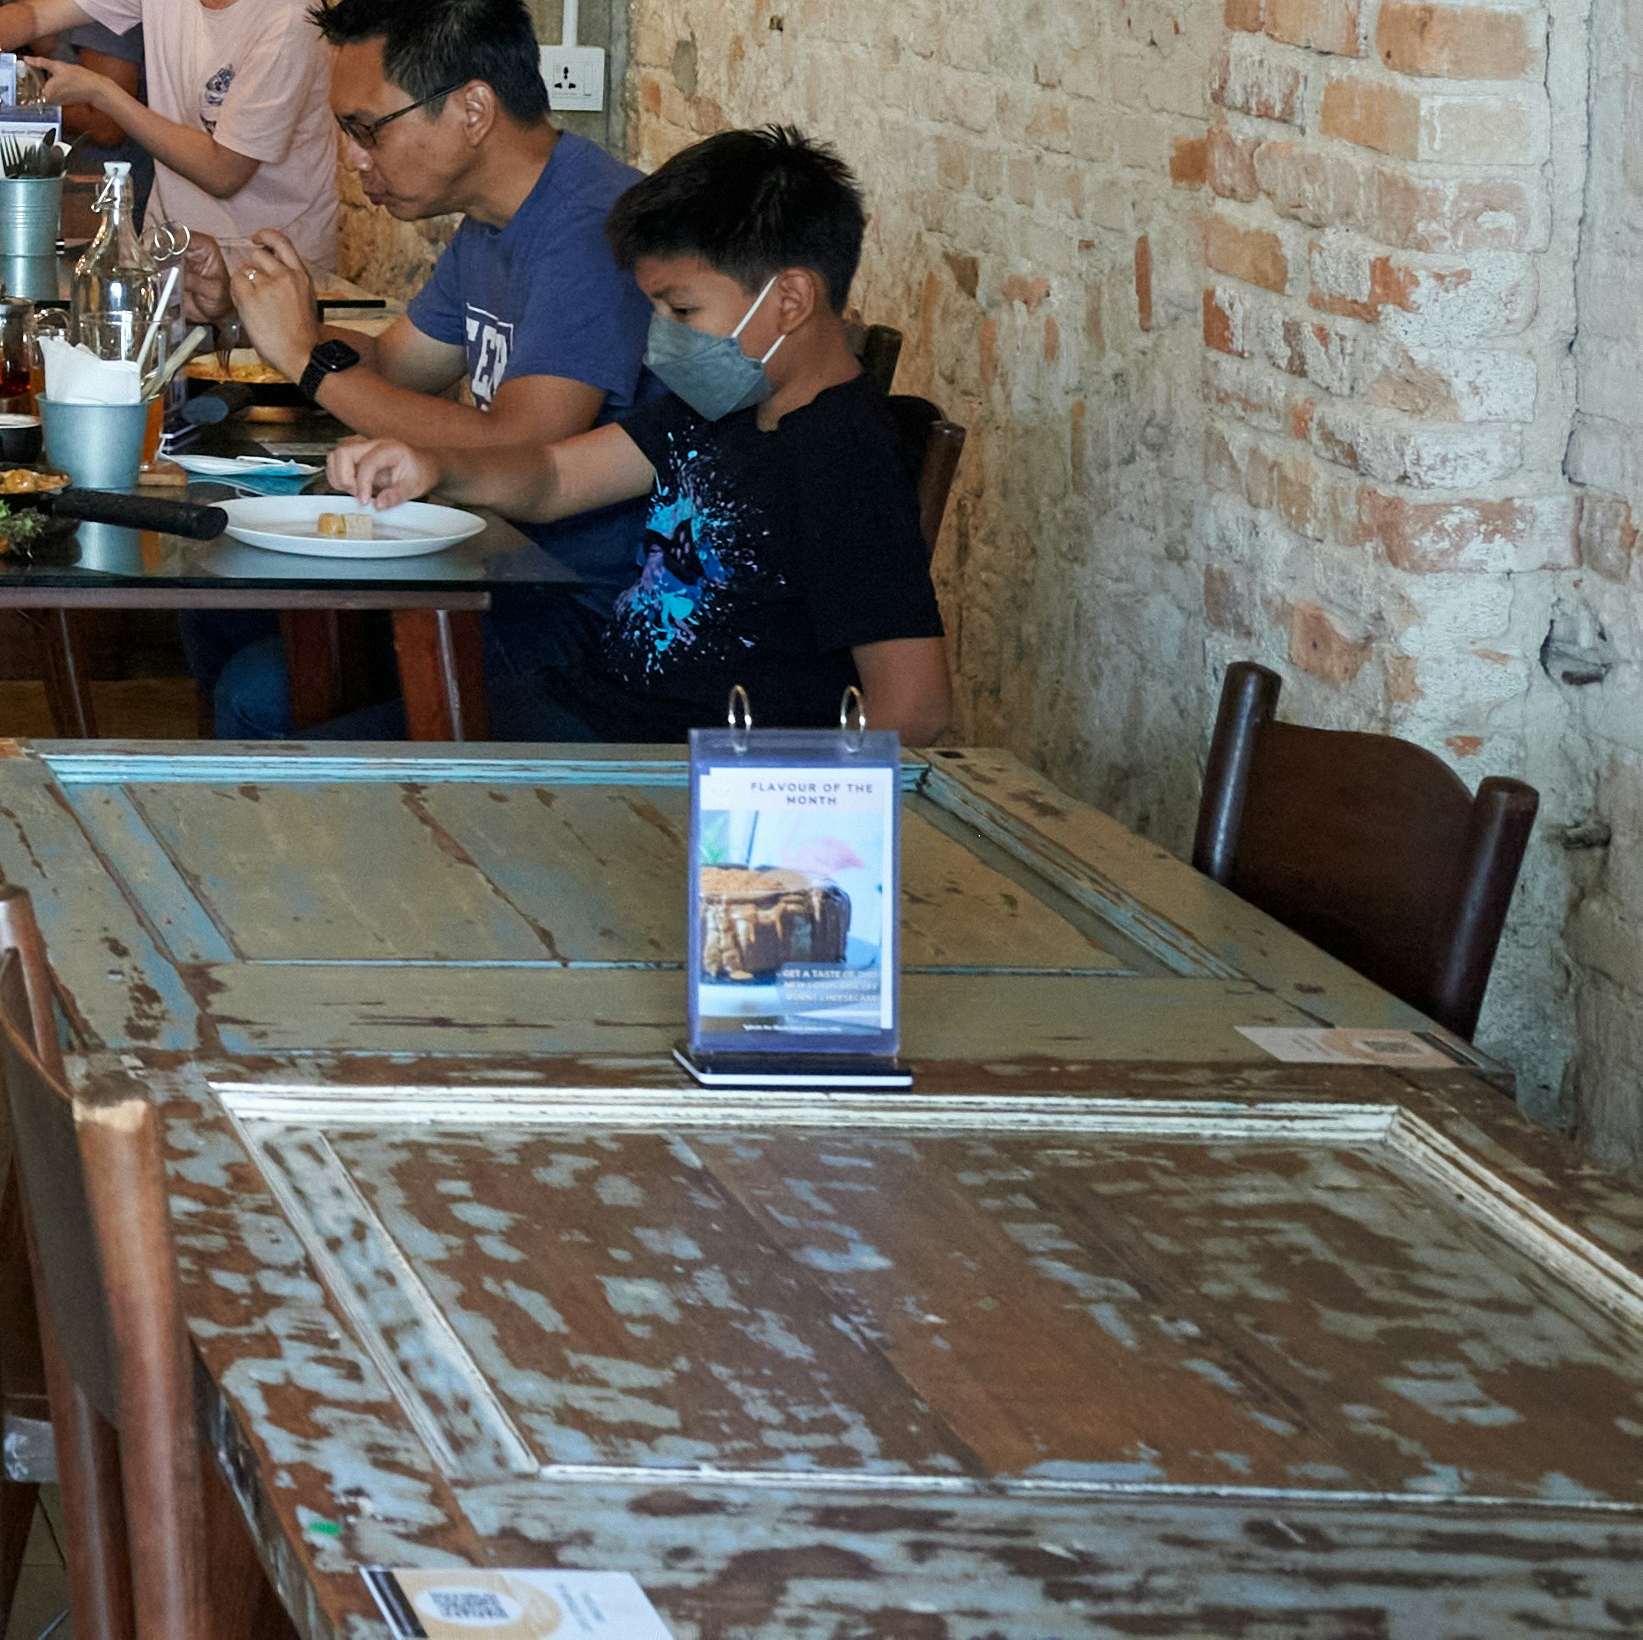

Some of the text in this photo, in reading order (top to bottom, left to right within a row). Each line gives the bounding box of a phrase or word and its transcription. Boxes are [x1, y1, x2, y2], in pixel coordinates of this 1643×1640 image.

[750, 782, 873, 793] FLAVOUR OF THE
[786, 795, 837, 806] MONTH
[802, 969, 811, 978] A
[812, 969, 841, 979] TASTE
